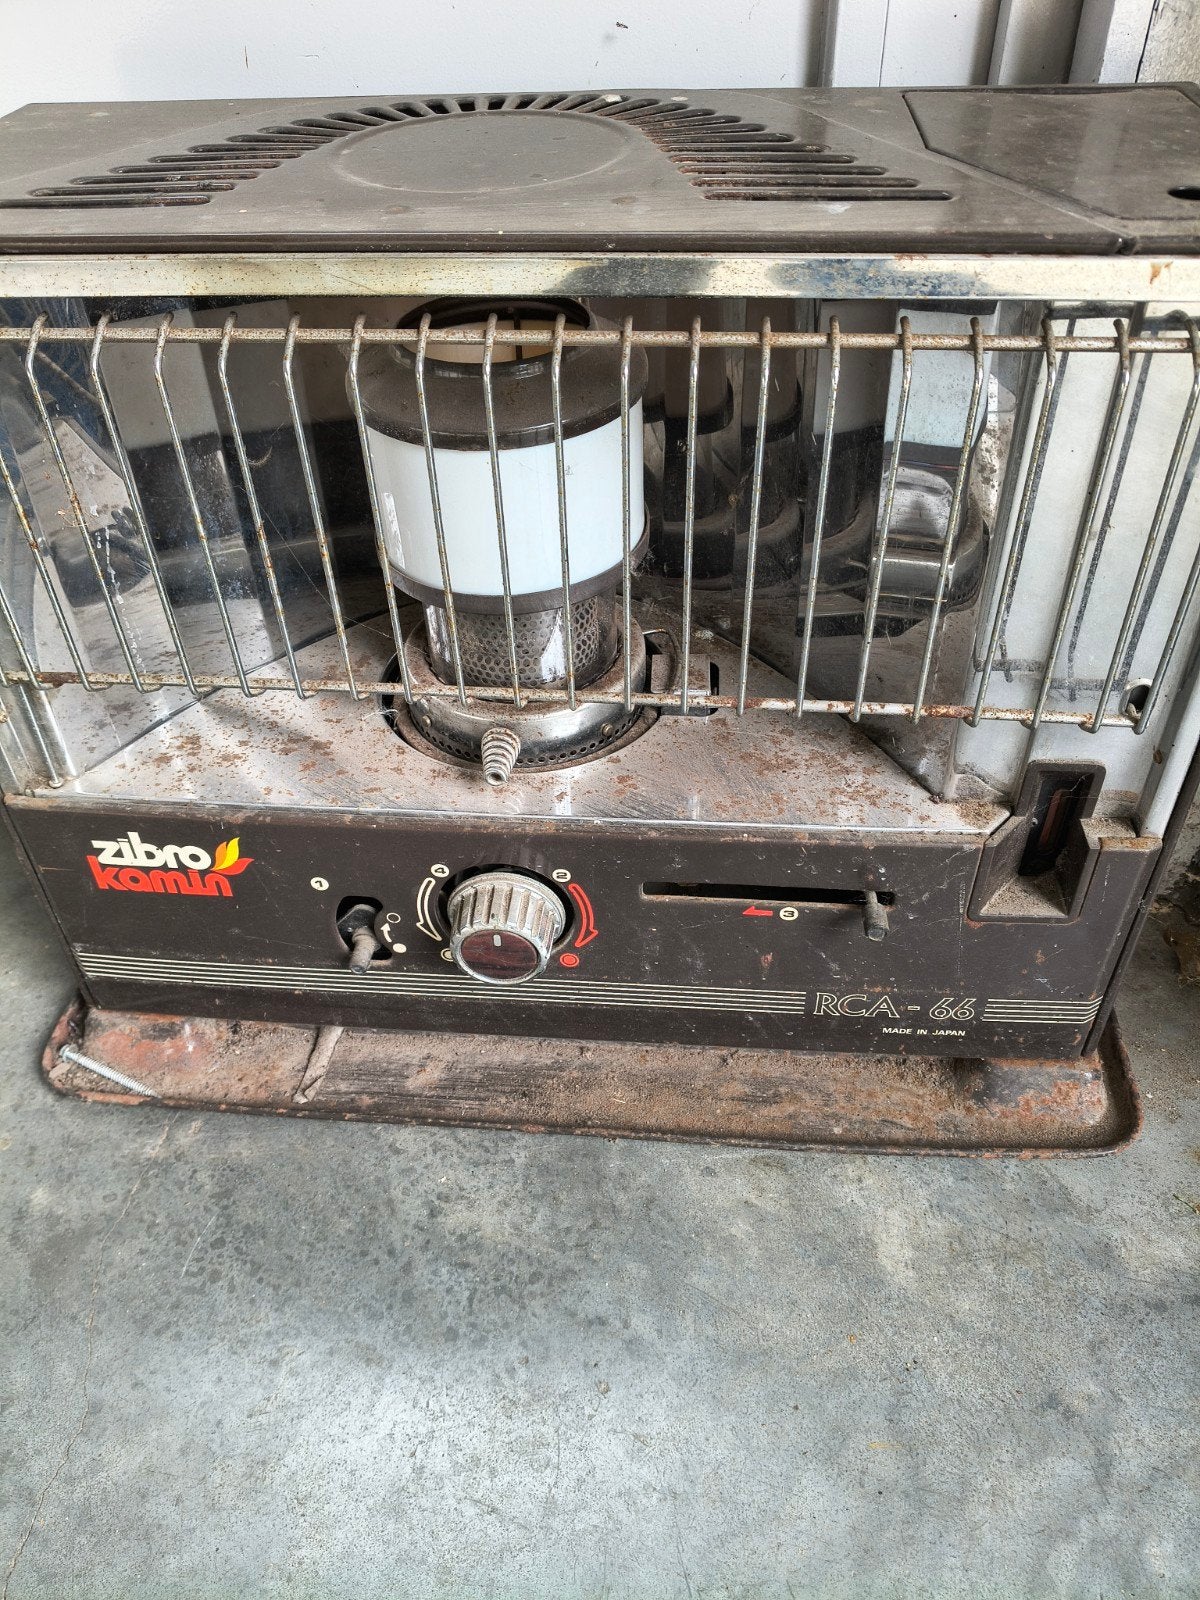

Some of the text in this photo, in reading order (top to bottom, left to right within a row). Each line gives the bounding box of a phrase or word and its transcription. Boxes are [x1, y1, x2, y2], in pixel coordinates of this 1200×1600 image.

[91, 831, 212, 870] zibro
[86, 855, 233, 897] kamin
[813, 992, 900, 1018] RCA
[929, 998, 976, 1020] 66
[882, 1027, 913, 1035] MADE
[932, 1029, 966, 1037] JAPAN
